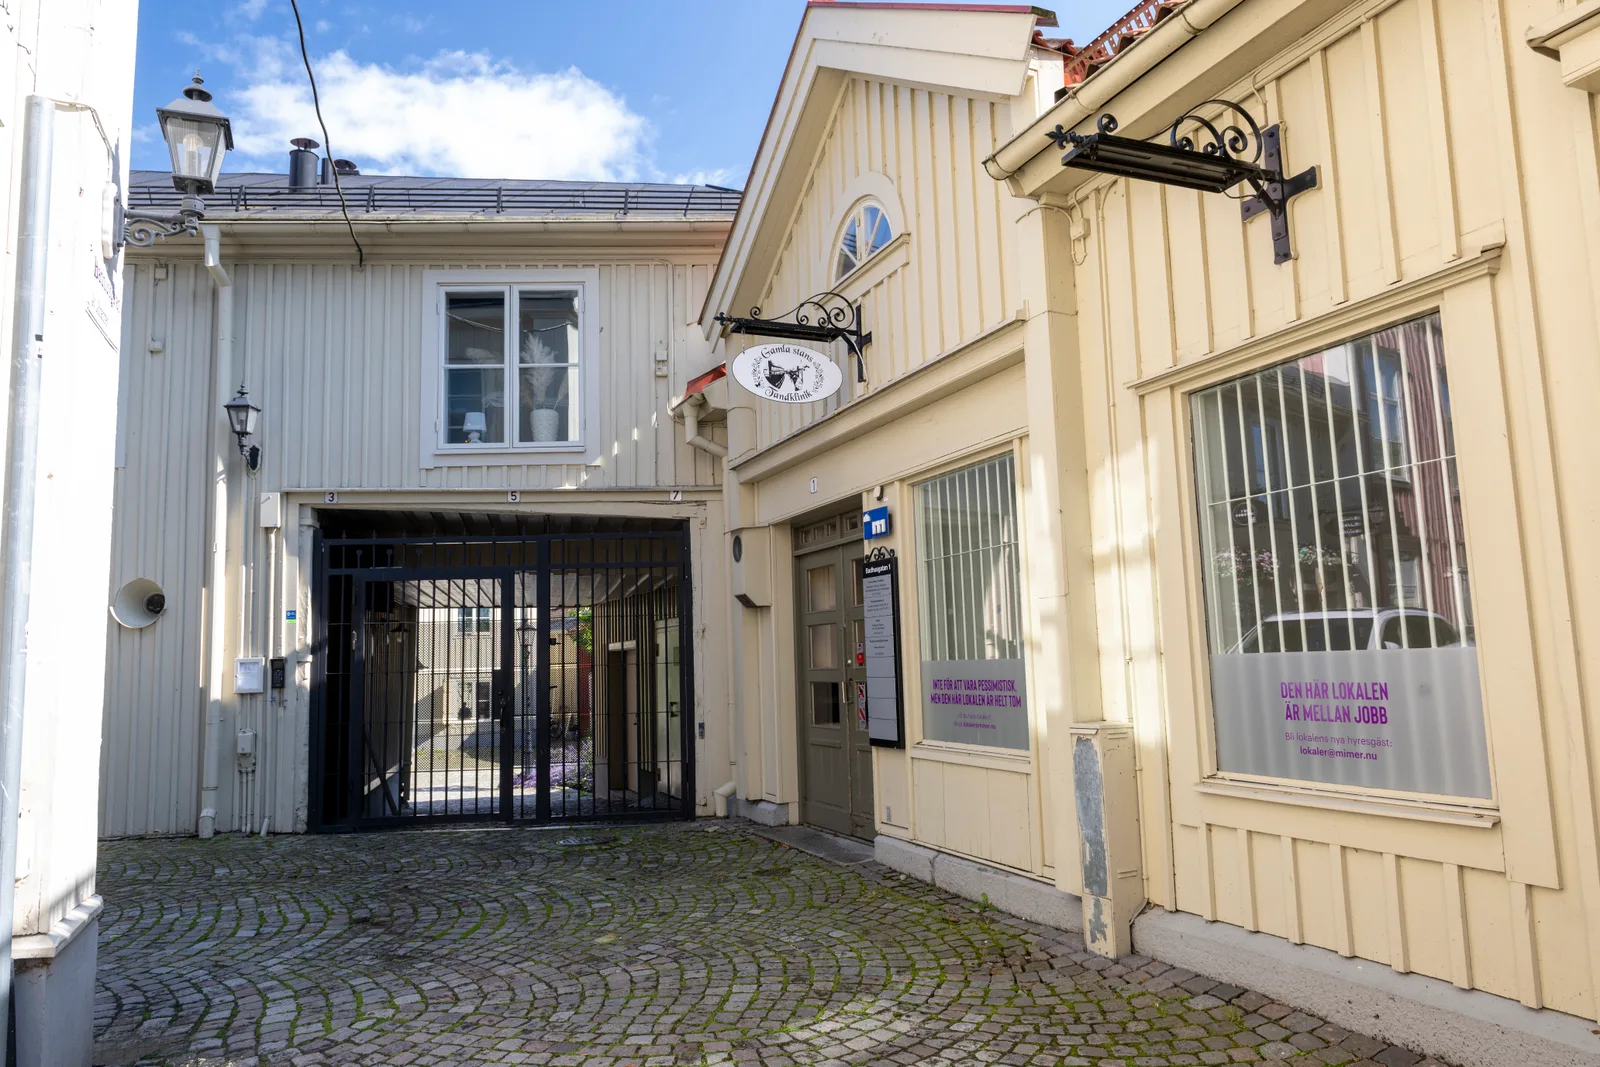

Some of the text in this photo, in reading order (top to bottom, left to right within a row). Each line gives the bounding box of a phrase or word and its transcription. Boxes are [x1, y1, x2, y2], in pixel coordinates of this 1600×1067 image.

[760, 344, 814, 362] Gamla stans
[765, 386, 813, 401] Tandklinik
[328, 492, 335, 502] 3
[510, 491, 517, 501] 5
[673, 490, 680, 500] 7
[871, 519, 886, 535] m
[932, 680, 943, 690] INTE
[944, 678, 953, 690] FÖR
[954, 680, 962, 690] ATT
[964, 680, 977, 691] VARA
[1280, 679, 1389, 700] DEN HÄR LOKALEN
[930, 692, 1022, 707] MEN DEN HÄR LOKALEN ÄR HELT TOM
[1285, 700, 1388, 725] ÄR MELLAN JOBB
[1285, 732, 1393, 748] Bli lokalens nya hyresgäst:
[1299, 745, 1378, 761] lokaler@mimer.nu
